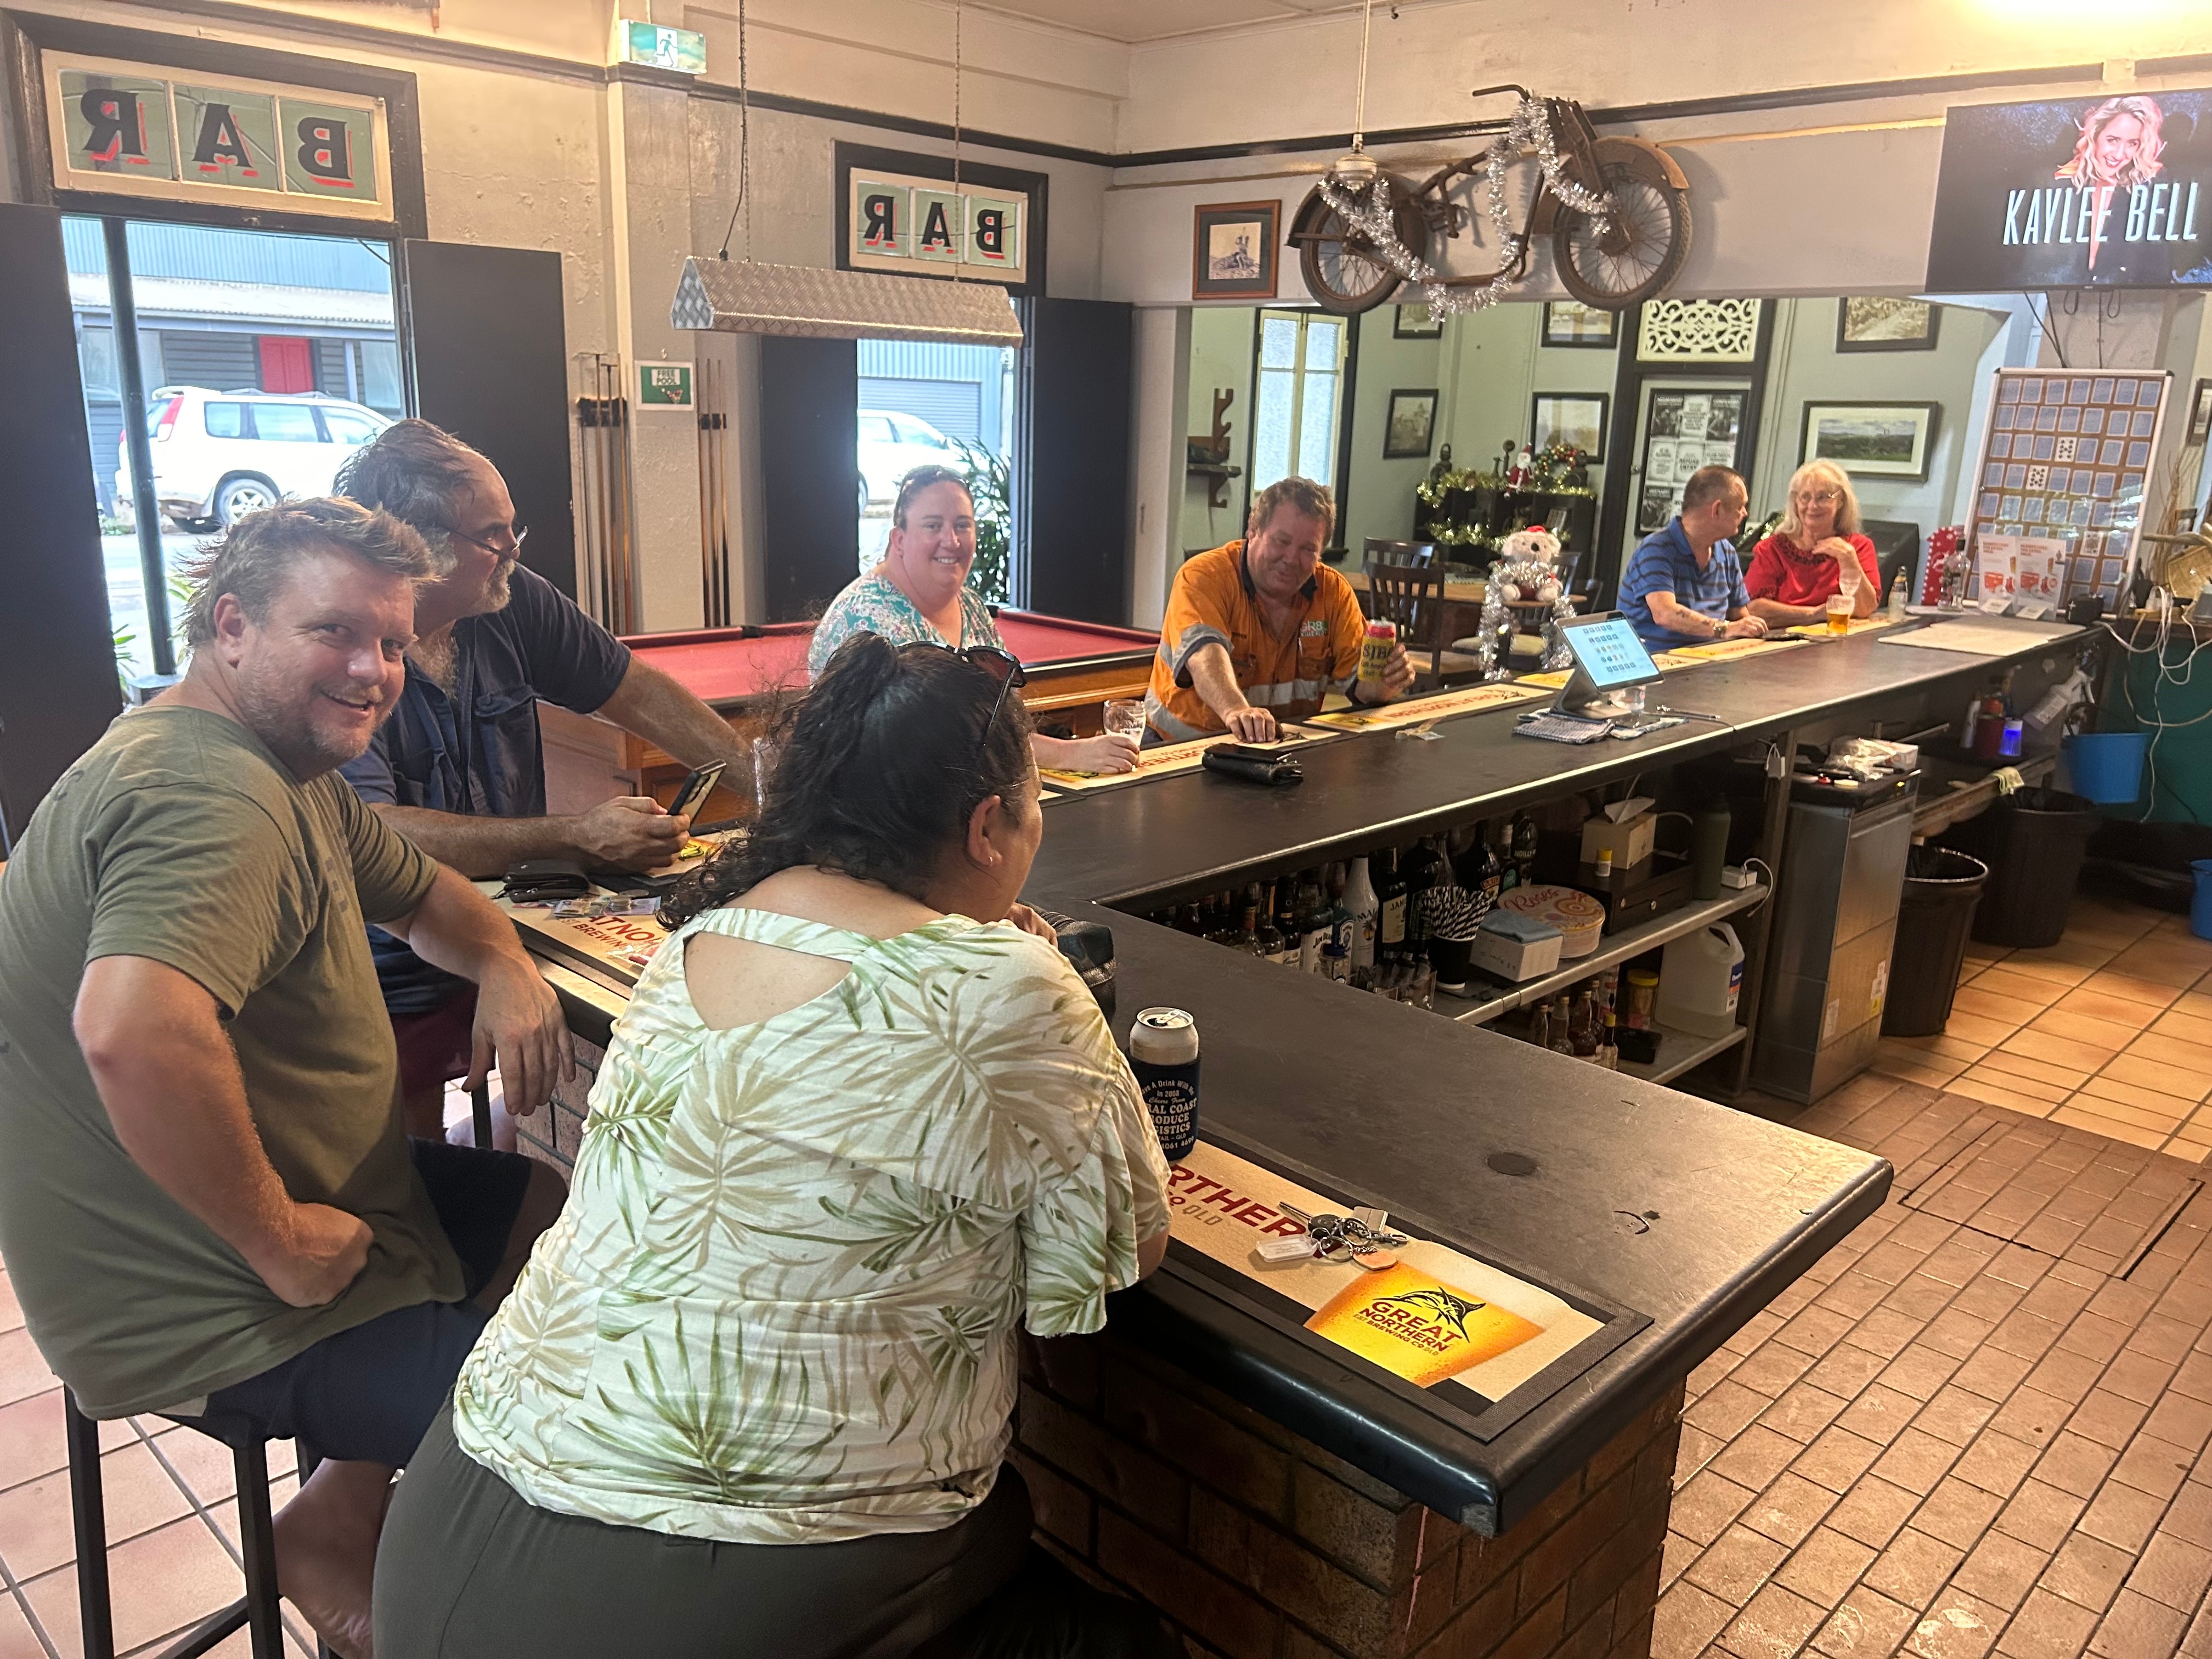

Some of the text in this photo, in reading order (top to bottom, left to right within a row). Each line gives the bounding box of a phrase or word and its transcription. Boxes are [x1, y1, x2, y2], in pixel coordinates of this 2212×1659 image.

[2002, 182, 2198, 245] KAYLEE BELL
[1504, 888, 1560, 911] Roses
[572, 923, 628, 948] BREWIN
[1142, 1085, 1152, 1094] ave
[1165, 1090, 1180, 1098] 2008
[1146, 1097, 1198, 1114] RAL COAST
[1150, 1112, 1190, 1125] RODUCE
[1154, 1121, 1190, 1135] GISTICS
[1167, 1164, 1344, 1259] RTHER
[1182, 1204, 1223, 1226] QLD
[1359, 1308, 1449, 1352] NORTHERN
[1366, 1320, 1411, 1342] BREWING
[1372, 1301, 1463, 1342] GREAT
